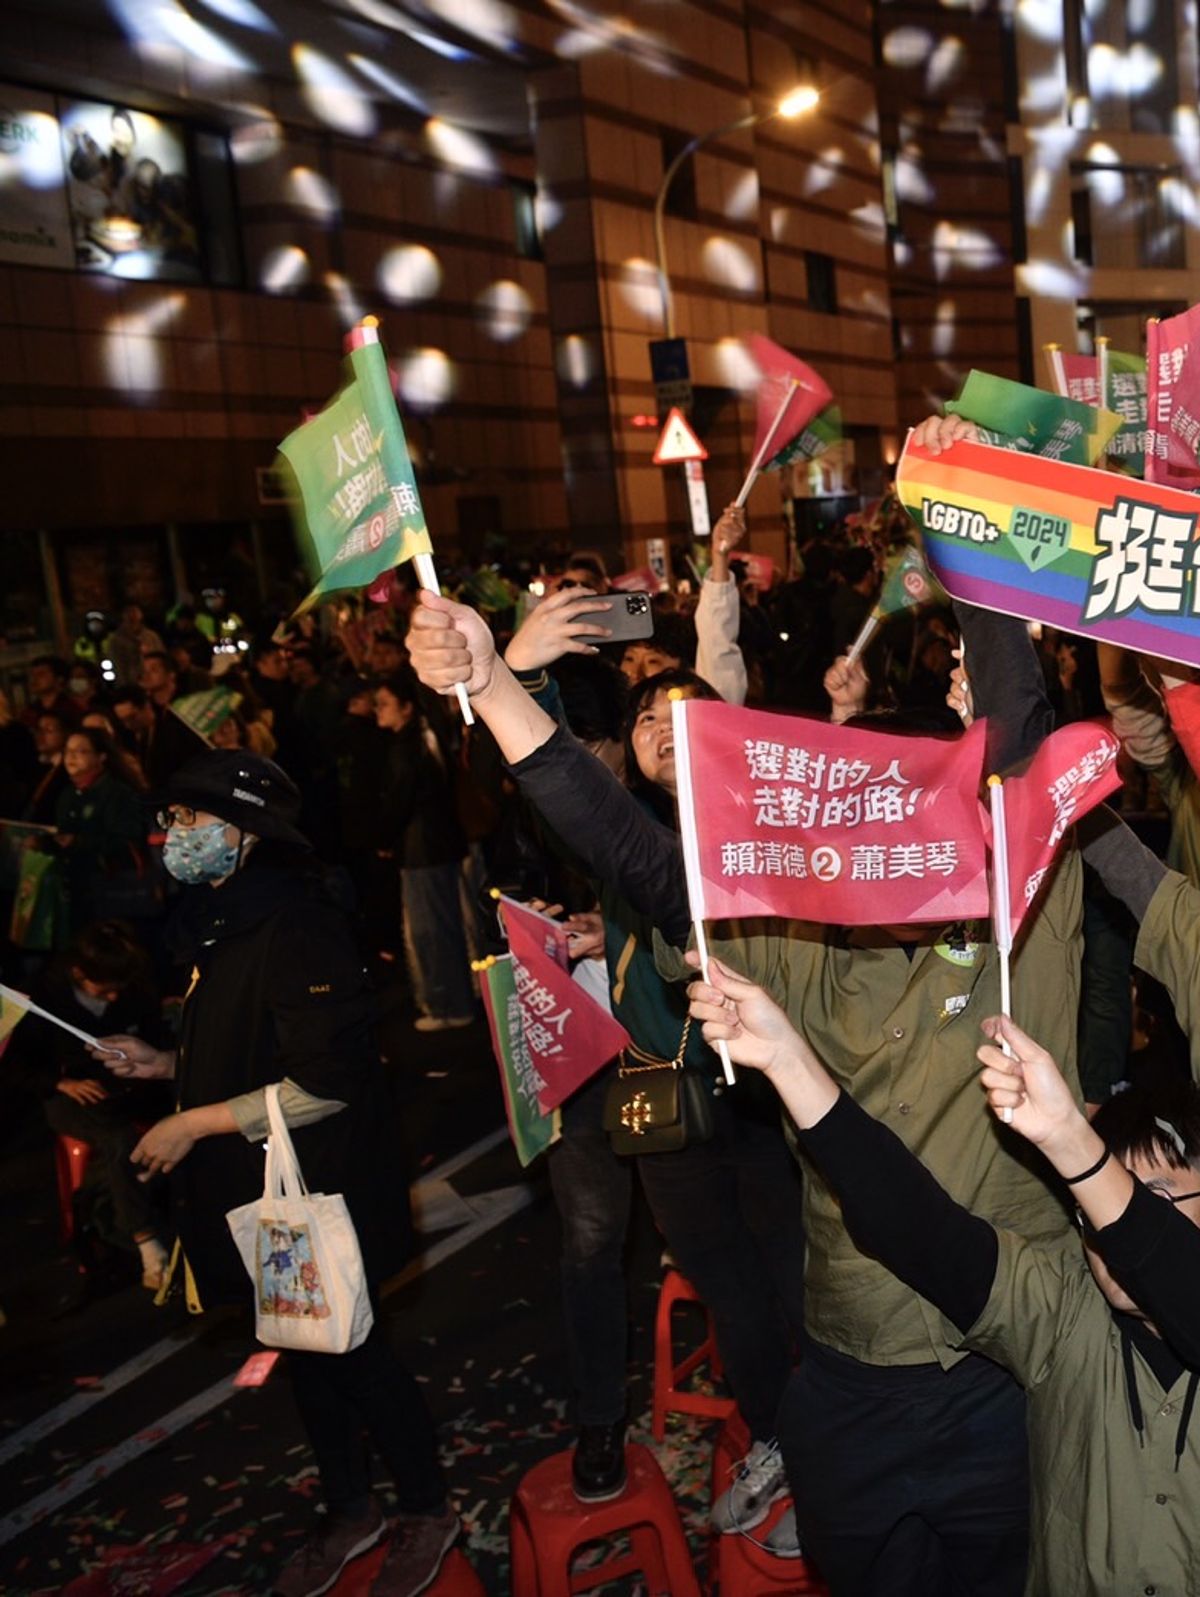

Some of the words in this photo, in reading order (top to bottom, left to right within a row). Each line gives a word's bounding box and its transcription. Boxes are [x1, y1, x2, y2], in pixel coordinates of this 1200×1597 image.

[921, 498, 1000, 543] LGBTQ+
[1013, 510, 1068, 548] 2024
[744, 739, 910, 793] 選對的人
[752, 784, 924, 829] 走對的路!
[720, 840, 808, 879] 賴清德
[850, 840, 959, 881] 蕭美琴
